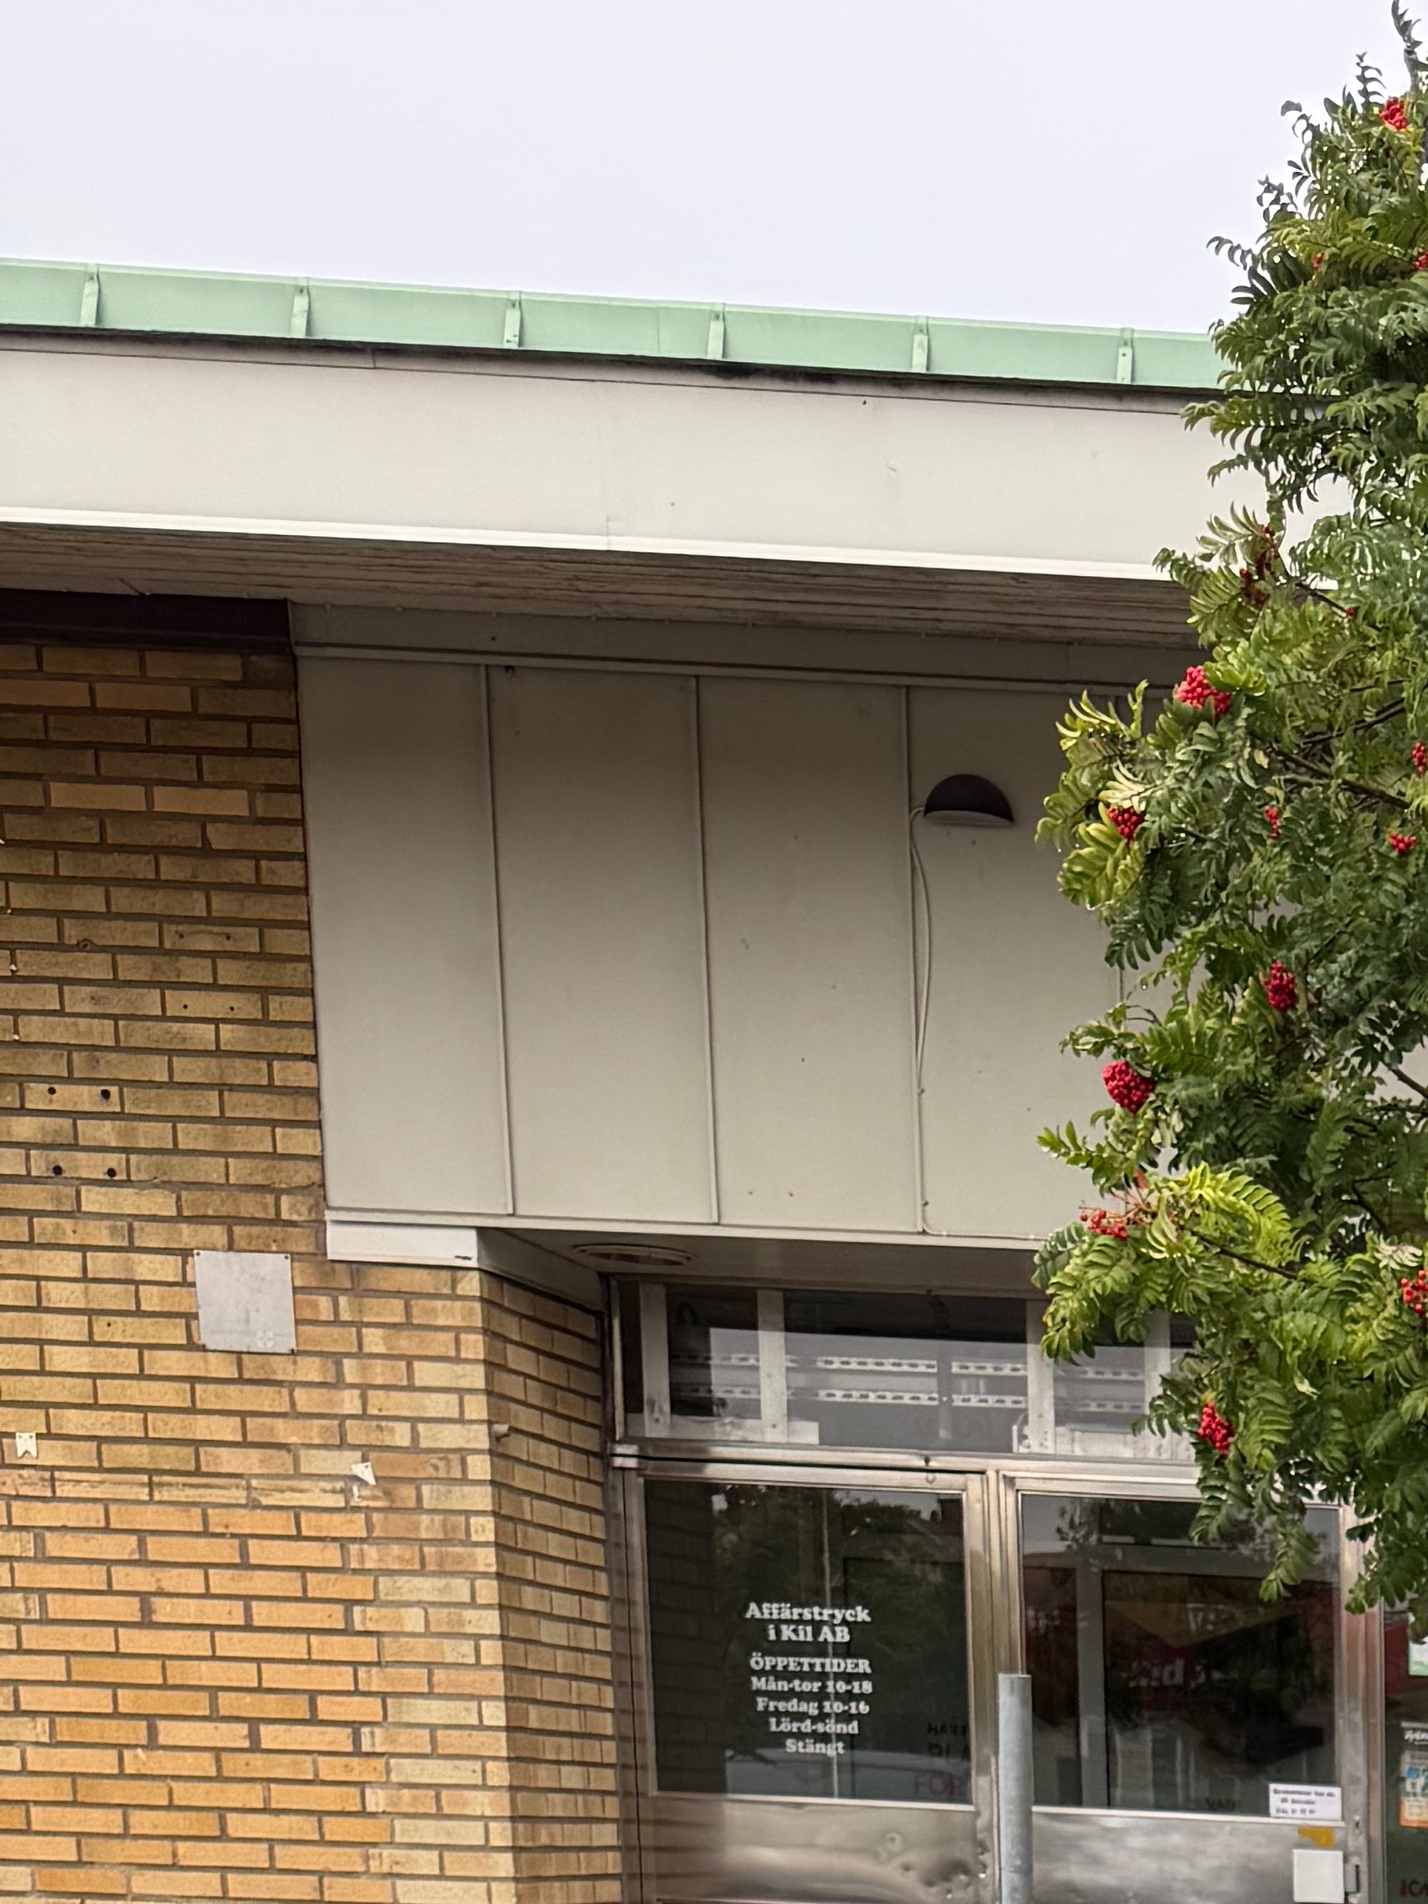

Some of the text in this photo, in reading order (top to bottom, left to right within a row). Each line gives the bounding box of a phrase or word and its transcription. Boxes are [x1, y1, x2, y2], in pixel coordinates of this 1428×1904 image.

[745, 1602, 871, 1624] Affärstryck
[767, 1624, 850, 1642] i Kil AB
[750, 1651, 872, 1673] ÖPPETTIDER
[751, 1676, 873, 1694] Mån-tor 10-18
[756, 1697, 870, 1716] Fredag 10-16
[769, 1717, 858, 1734] Lörd-sönd
[785, 1738, 844, 1757] Stängt
